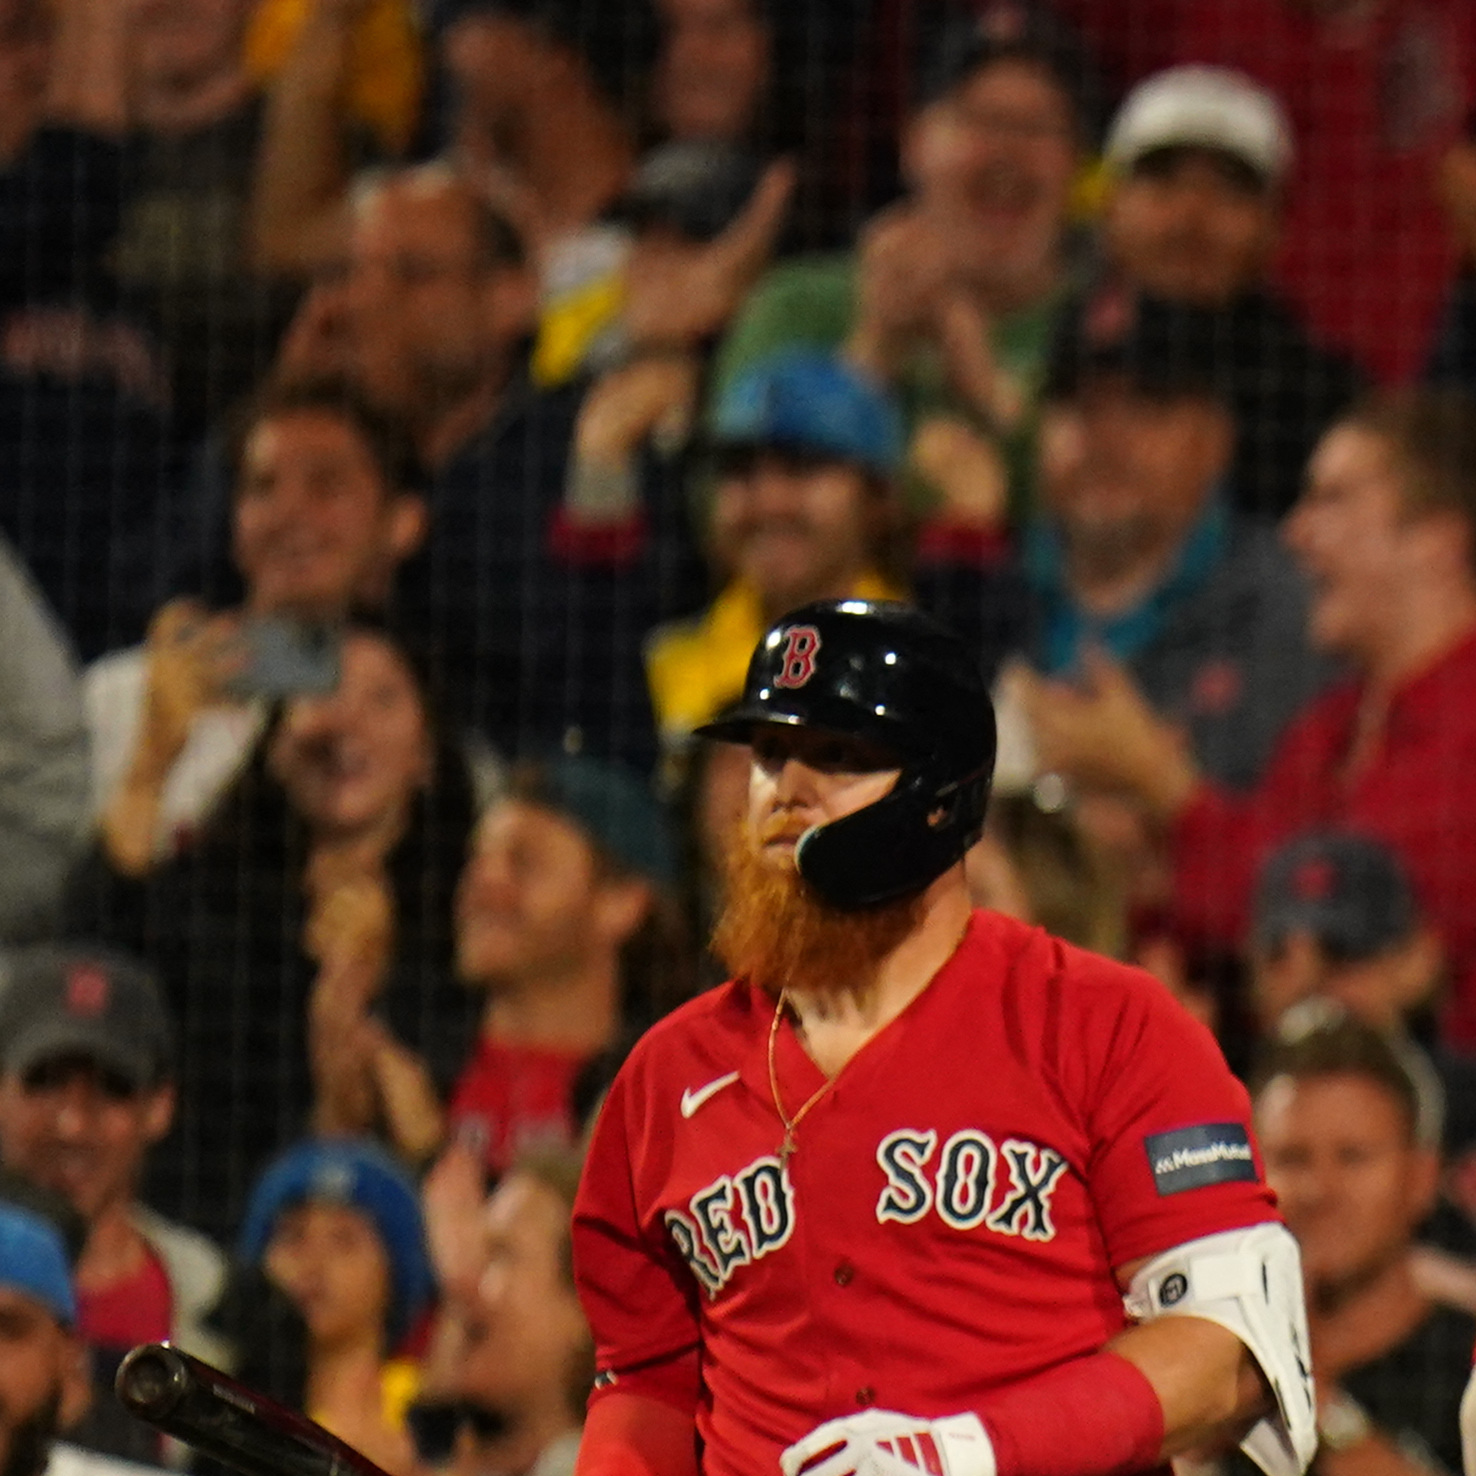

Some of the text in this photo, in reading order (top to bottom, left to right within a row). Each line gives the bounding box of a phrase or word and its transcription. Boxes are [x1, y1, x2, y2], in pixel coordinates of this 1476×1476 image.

[773, 625, 822, 689] B
[664, 1128, 1069, 1301] RED SOX
